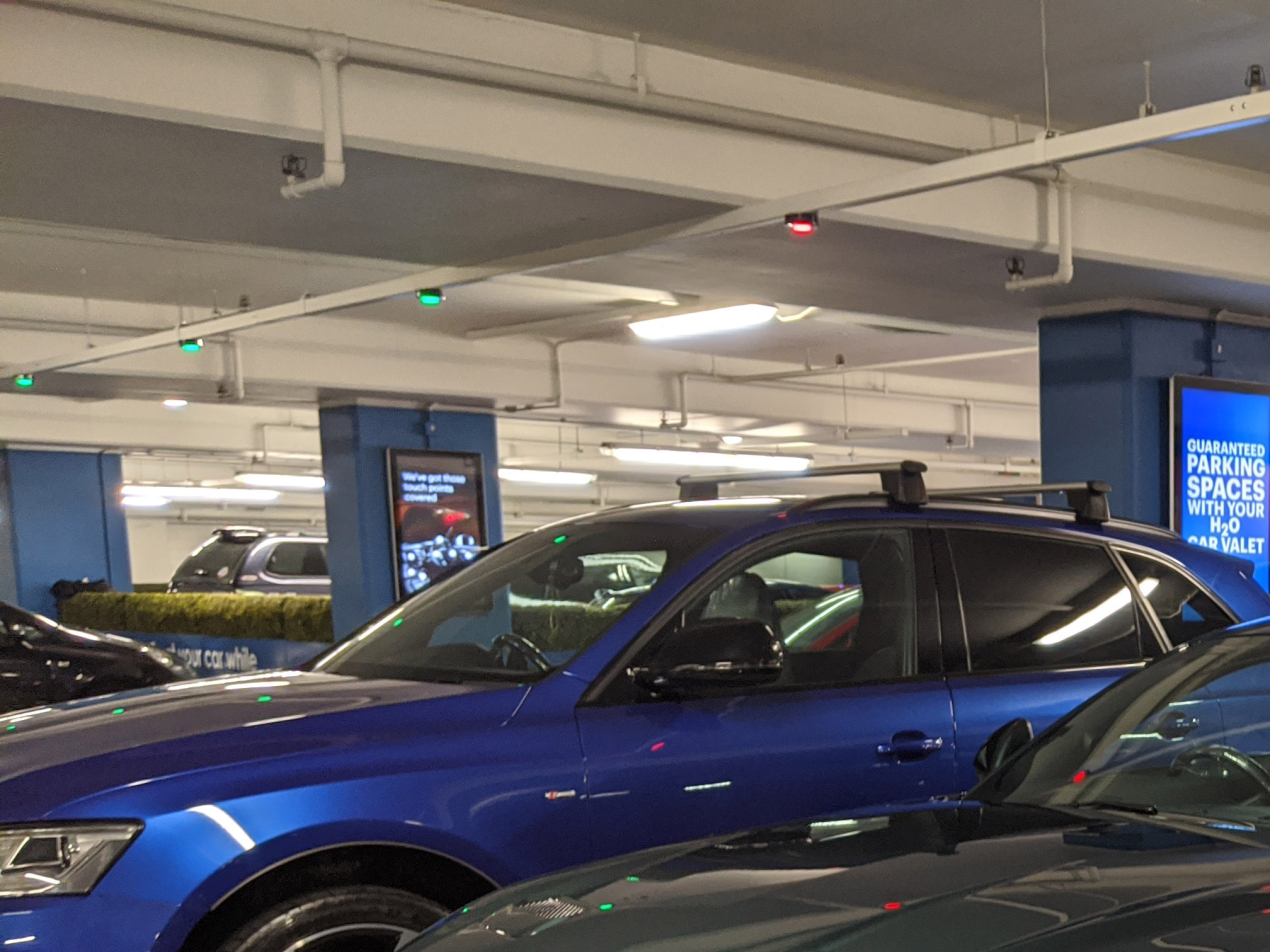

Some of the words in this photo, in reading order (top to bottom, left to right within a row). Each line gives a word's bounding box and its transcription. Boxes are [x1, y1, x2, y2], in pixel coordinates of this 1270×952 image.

[1187, 438, 1265, 457] GUARANTEED
[1187, 454, 1266, 478] PARKING
[1187, 475, 1265, 501] SPACES
[1187, 498, 1224, 516] WITH
[1227, 501, 1265, 518] YOUR
[1209, 516, 1241, 537] H2O
[1220, 536, 1265, 554] VALET
[204, 650, 224, 670] car
[225, 646, 258, 671] while
